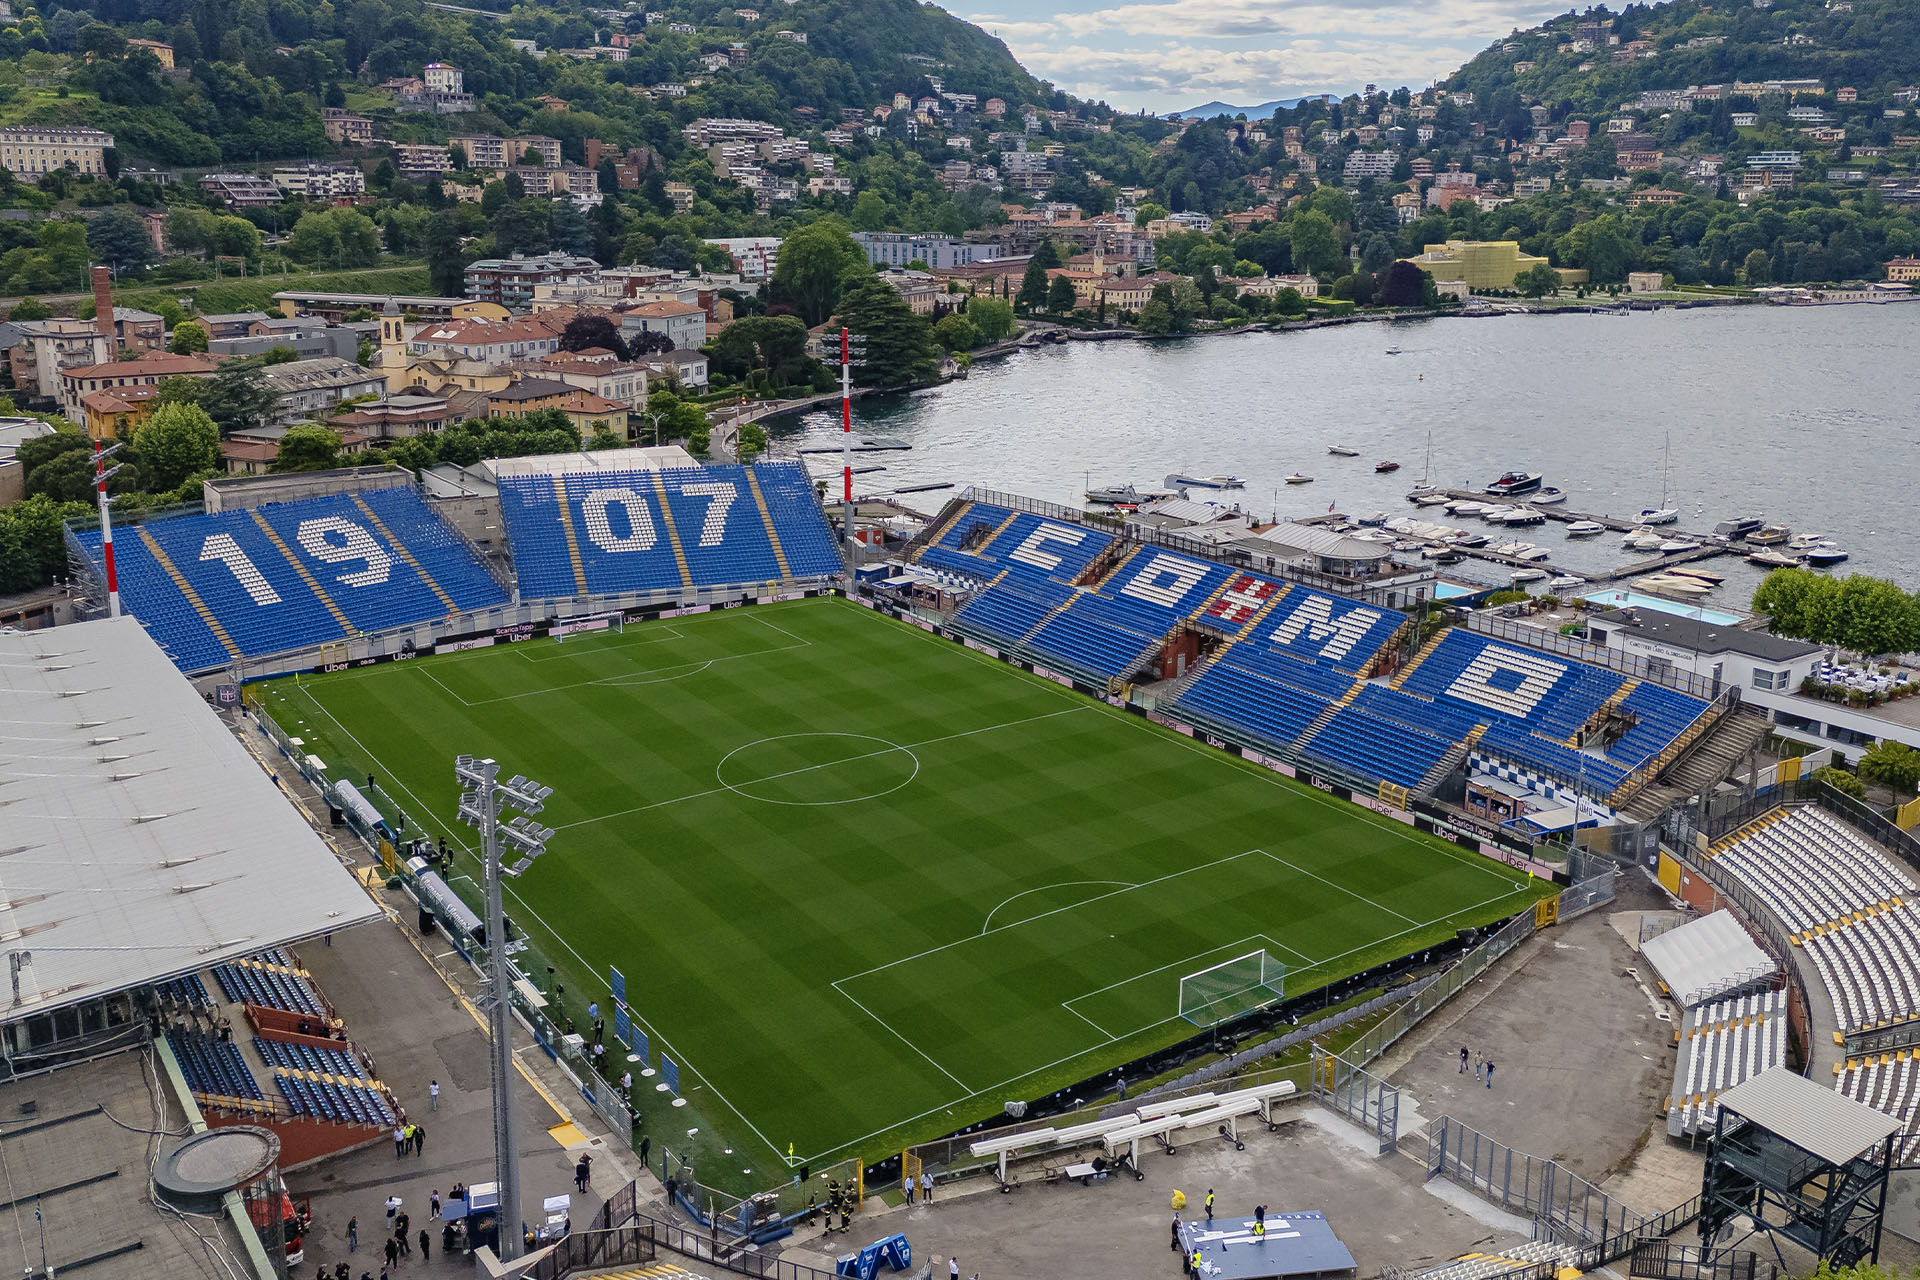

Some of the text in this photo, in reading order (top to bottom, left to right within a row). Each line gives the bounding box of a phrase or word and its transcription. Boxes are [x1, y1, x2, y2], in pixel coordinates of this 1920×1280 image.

[724, 601, 743, 609] Uber
[675, 607, 694, 617] Uber
[624, 615, 644, 625] Uber
[496, 625, 519, 635] Scarica
[568, 622, 589, 633] Uber
[509, 633, 532, 643] Uber
[453, 641, 475, 651] Uber
[393, 651, 417, 661] Uber
[1008, 655, 1022, 668] Uber
[324, 662, 349, 673] Uber
[1161, 716, 1177, 731] Uber
[1207, 734, 1226, 750] Uber
[1257, 754, 1278, 770] Uber
[1311, 775, 1334, 793] Uber
[1370, 799, 1393, 817] Uber
[1433, 823, 1459, 844] Uber
[1447, 815, 1494, 840] Scarica l'app
[1500, 851, 1528, 872] Uber
